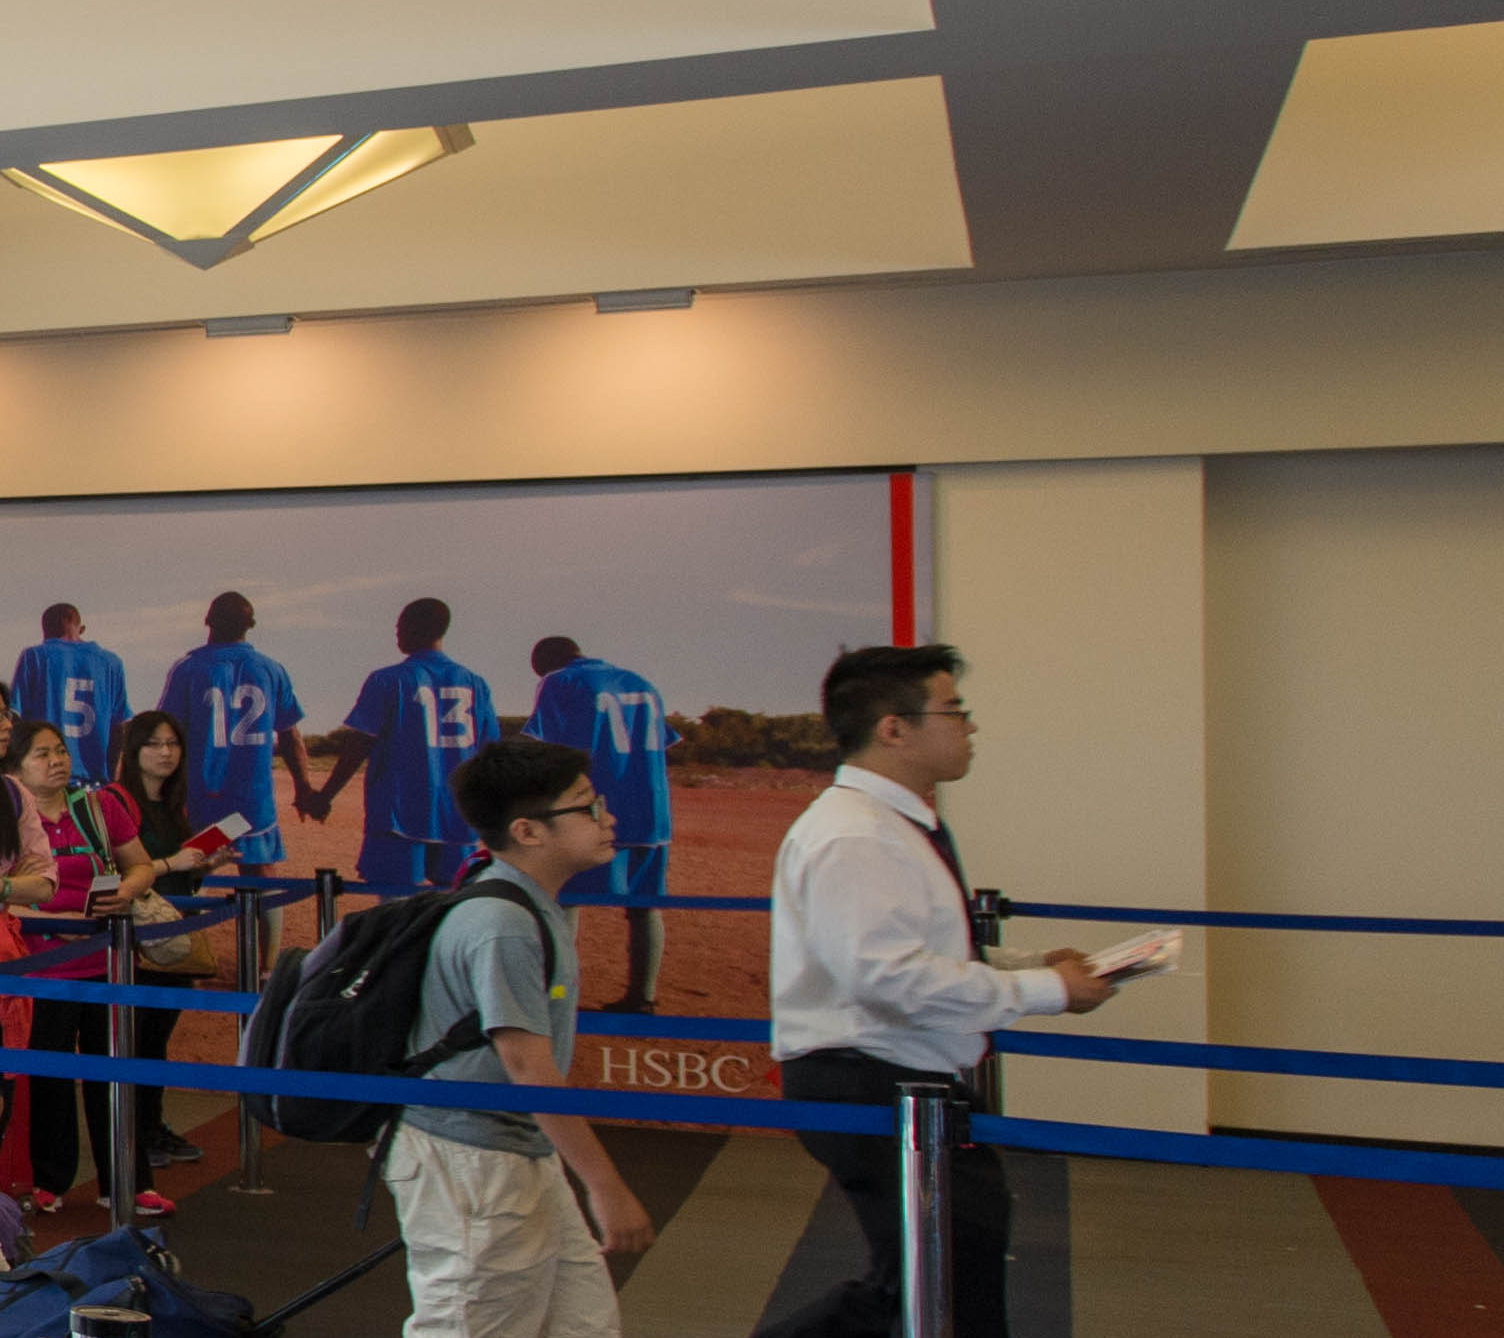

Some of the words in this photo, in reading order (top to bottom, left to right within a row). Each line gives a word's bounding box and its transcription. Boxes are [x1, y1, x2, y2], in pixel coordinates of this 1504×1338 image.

[61, 676, 96, 738] 5
[203, 684, 267, 748] 12
[414, 685, 475, 749] 13
[597, 691, 661, 753] 17
[600, 1046, 752, 1093] HSBC
